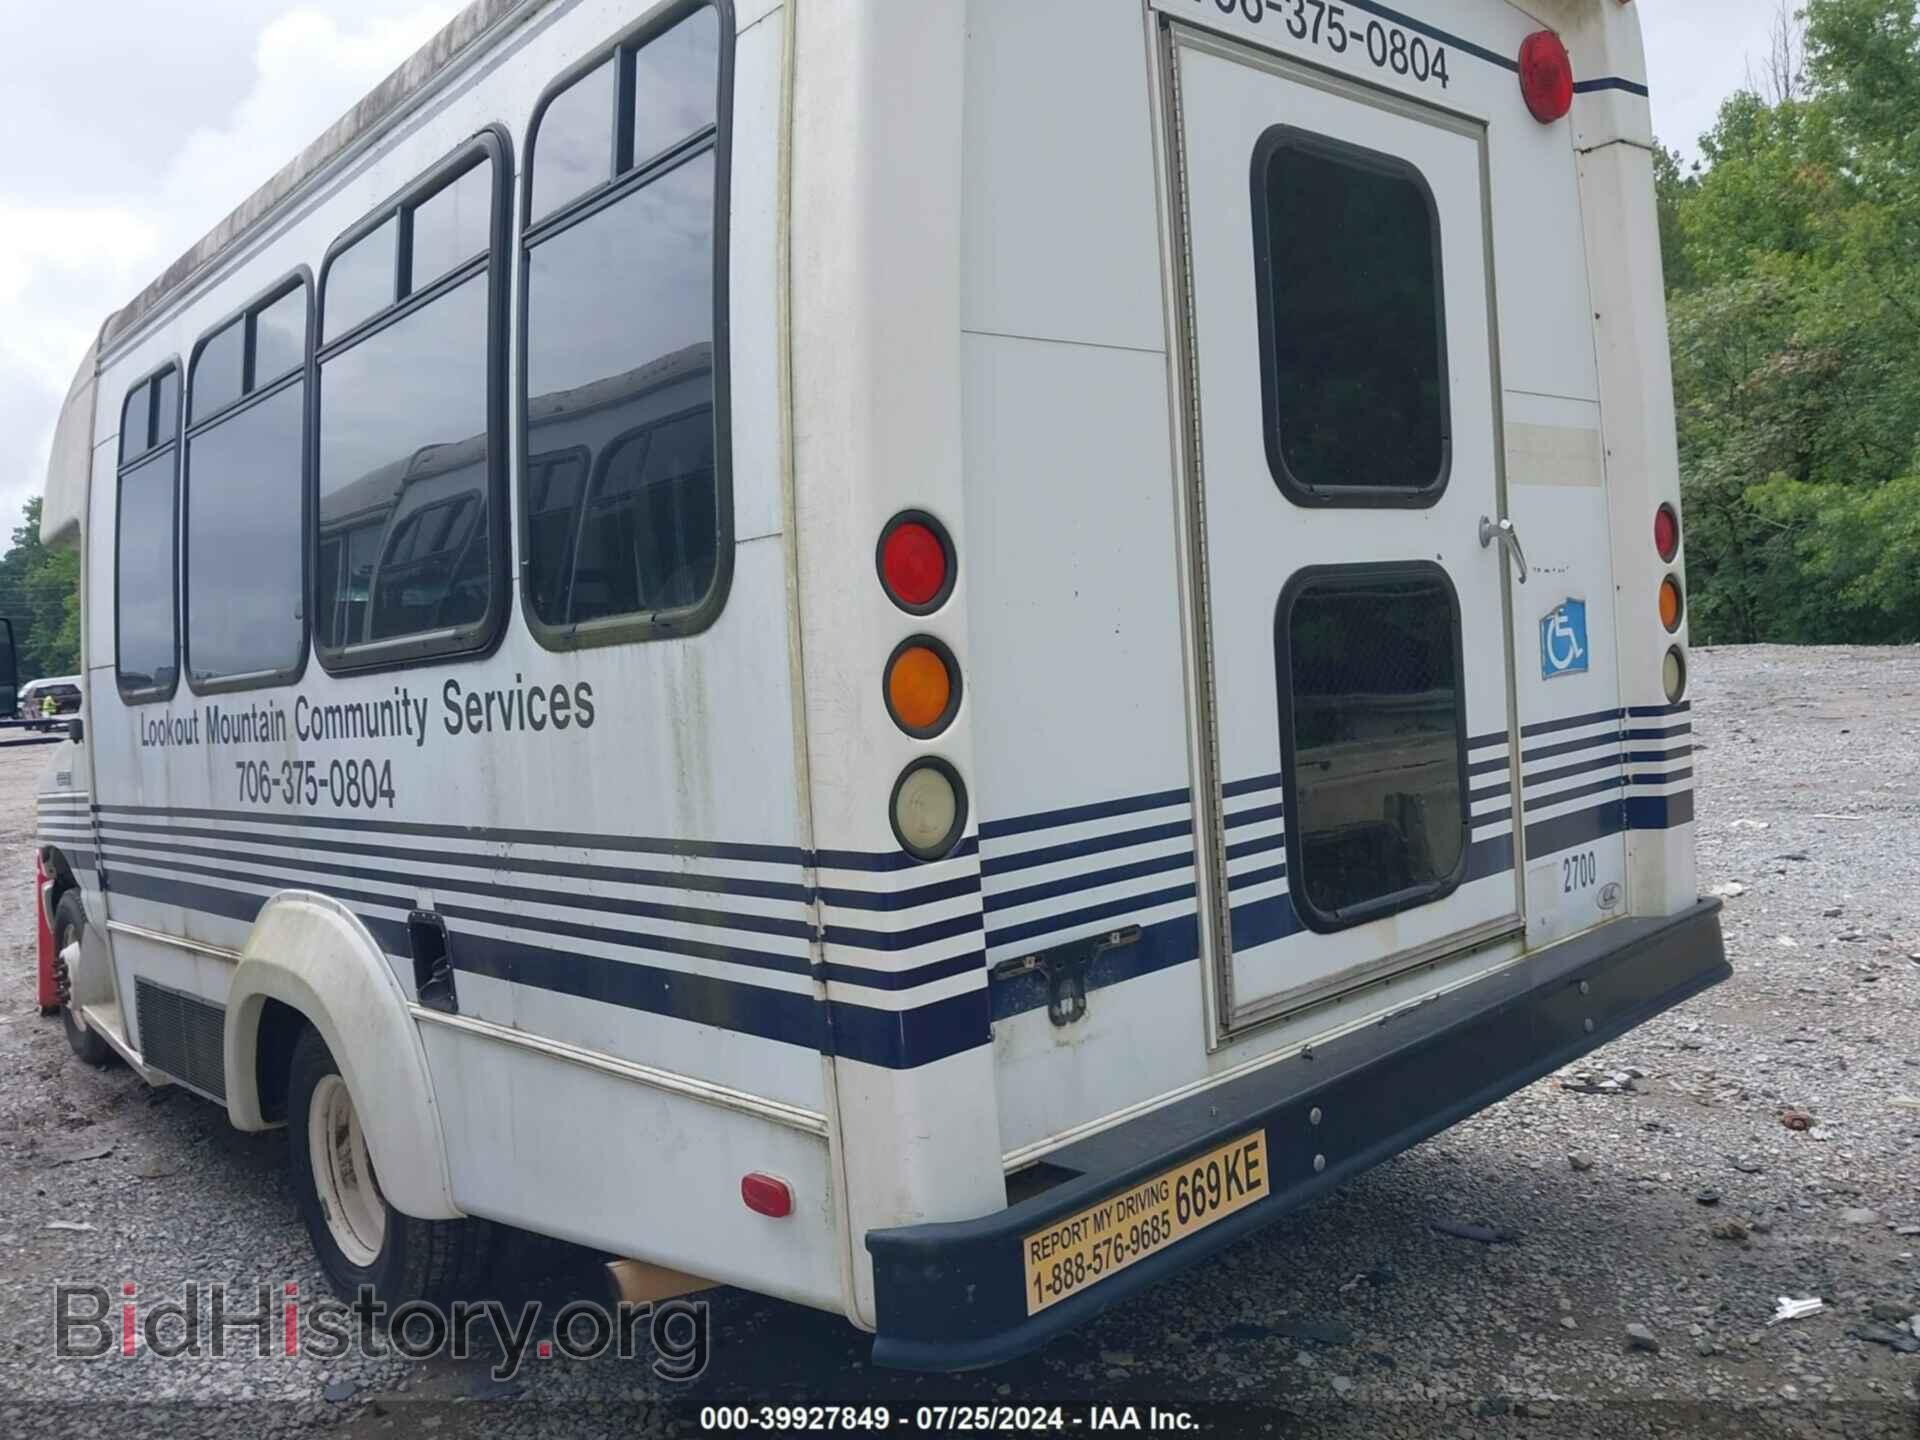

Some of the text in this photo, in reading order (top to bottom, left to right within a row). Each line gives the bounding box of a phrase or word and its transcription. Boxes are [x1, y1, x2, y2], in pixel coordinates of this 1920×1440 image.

[1194, 0, 1449, 89] 6-375-0804
[140, 672, 596, 747] Lookout Mountain Community Services
[235, 757, 396, 809] 706-375-0804
[1563, 850, 1597, 894] 2700
[1031, 1179, 1170, 1266] REPORT MY DRIVING
[1033, 1208, 1172, 1305] 1-888-576-9685
